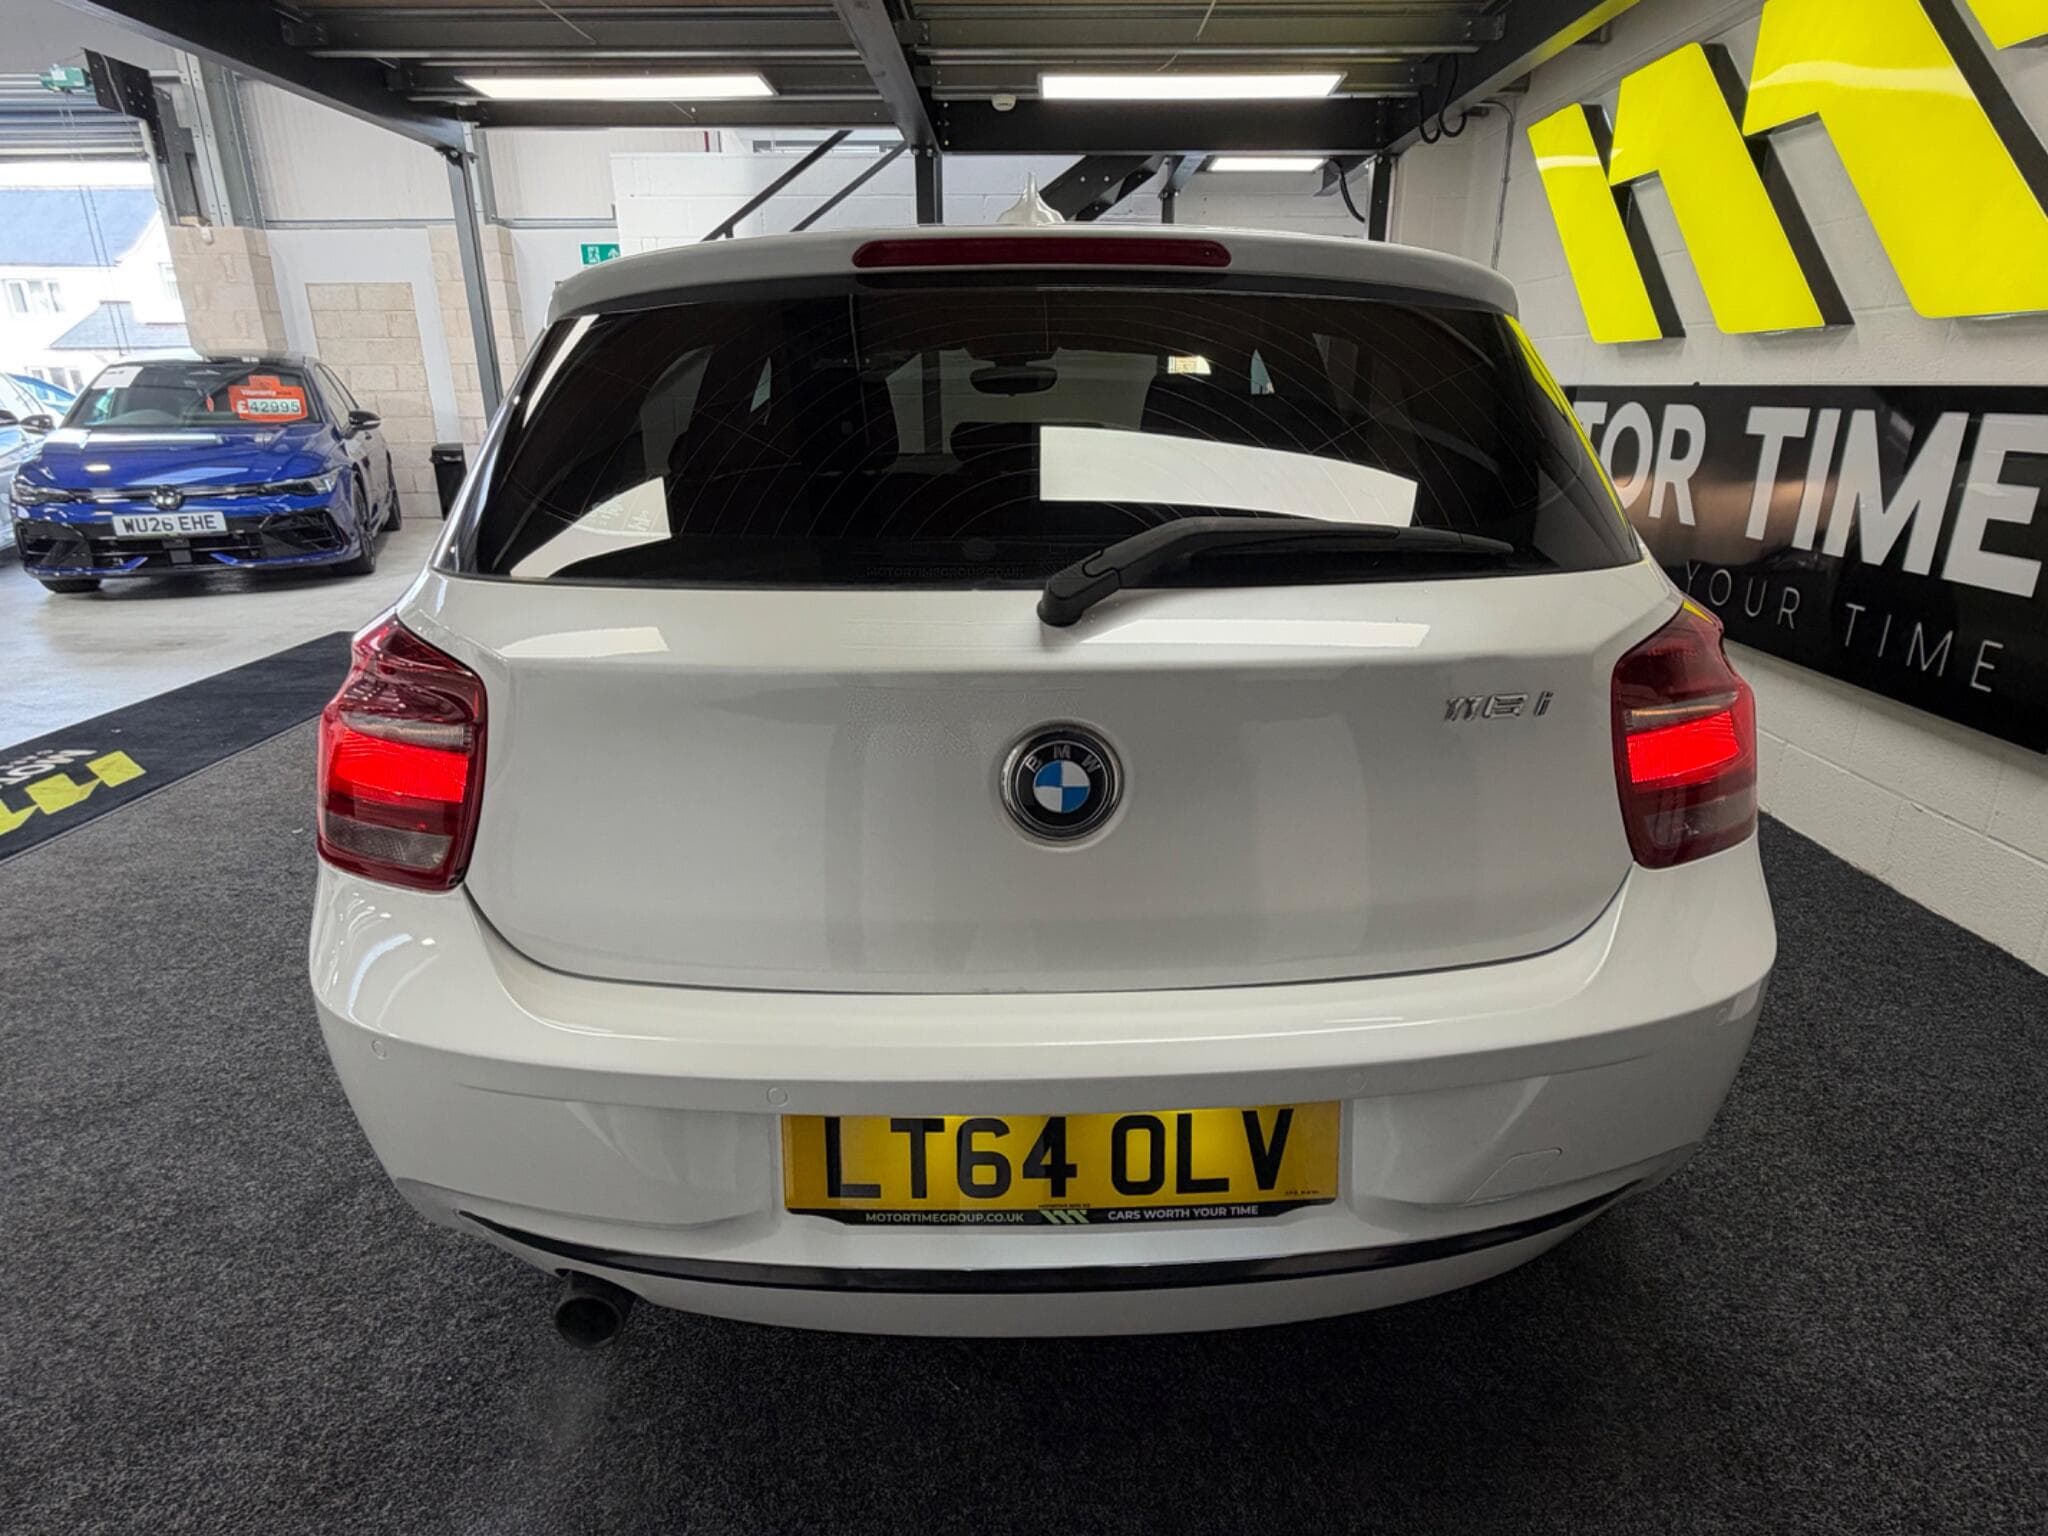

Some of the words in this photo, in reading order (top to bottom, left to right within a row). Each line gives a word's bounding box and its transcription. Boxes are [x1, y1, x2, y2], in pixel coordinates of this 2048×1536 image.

[1744, 407, 2048, 598] TIME
[122, 517, 174, 533] WU26
[178, 515, 217, 531] EHE
[1684, 560, 1800, 629] YOUR
[1845, 603, 2003, 692] TIME
[1025, 744, 1102, 773] BMW
[824, 1116, 1077, 1198] LT64
[1111, 1109, 1294, 1196] OLV
[865, 1212, 1024, 1223] MOTORTIMEGROUP.CO.UK
[1108, 1210, 1140, 1221] CARS
[1143, 1208, 1190, 1219] WORTH
[1192, 1207, 1227, 1217] YOUR
[1231, 1205, 1258, 1216] TIME
